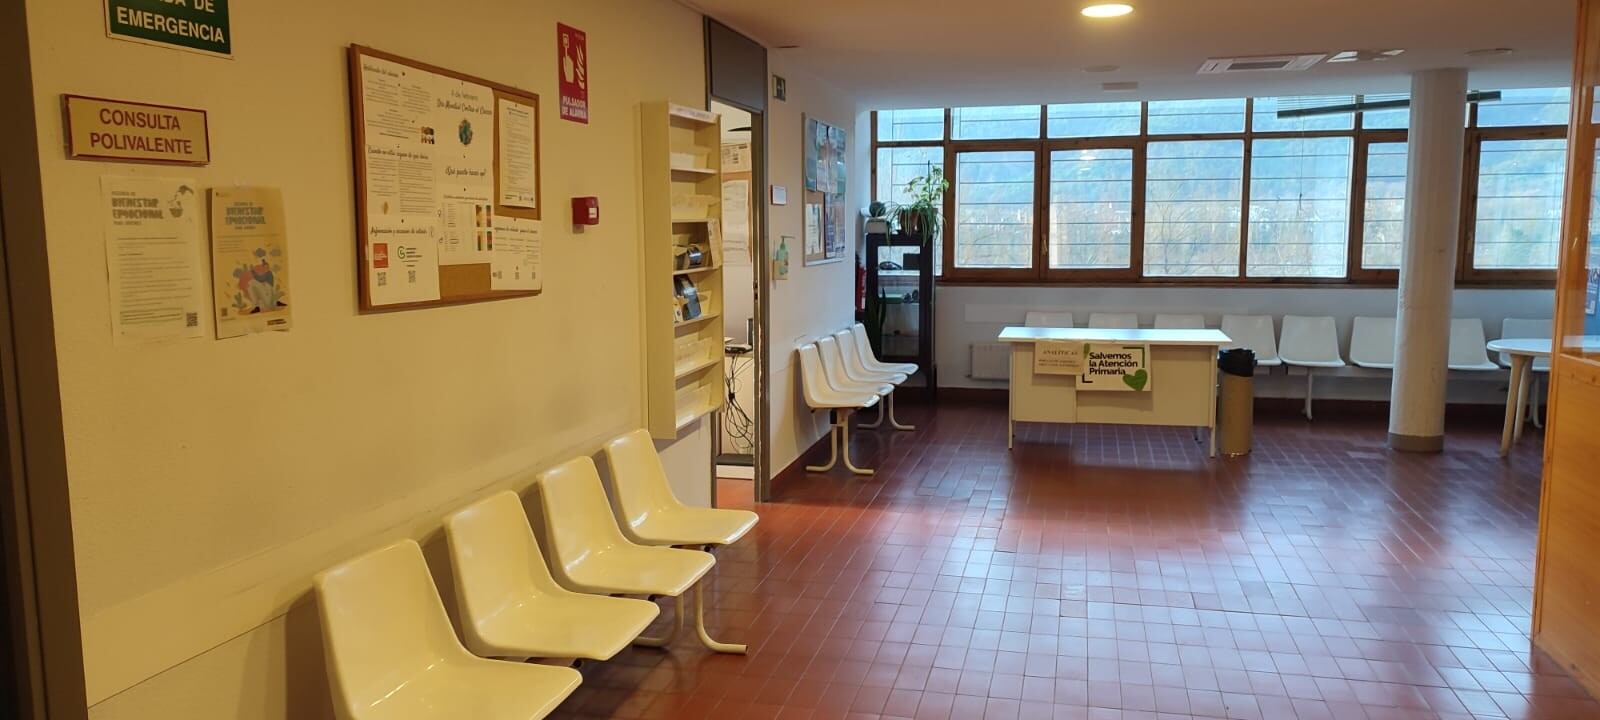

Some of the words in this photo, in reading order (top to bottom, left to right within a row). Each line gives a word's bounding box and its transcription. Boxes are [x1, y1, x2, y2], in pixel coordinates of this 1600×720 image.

[116, 6, 225, 43] EMERGENCIA
[99, 108, 181, 130] CONSULTA
[90, 132, 193, 154] POLIVALENTE
[1089, 352, 1132, 360] Salvemos
[1089, 367, 1126, 375] Primaria
